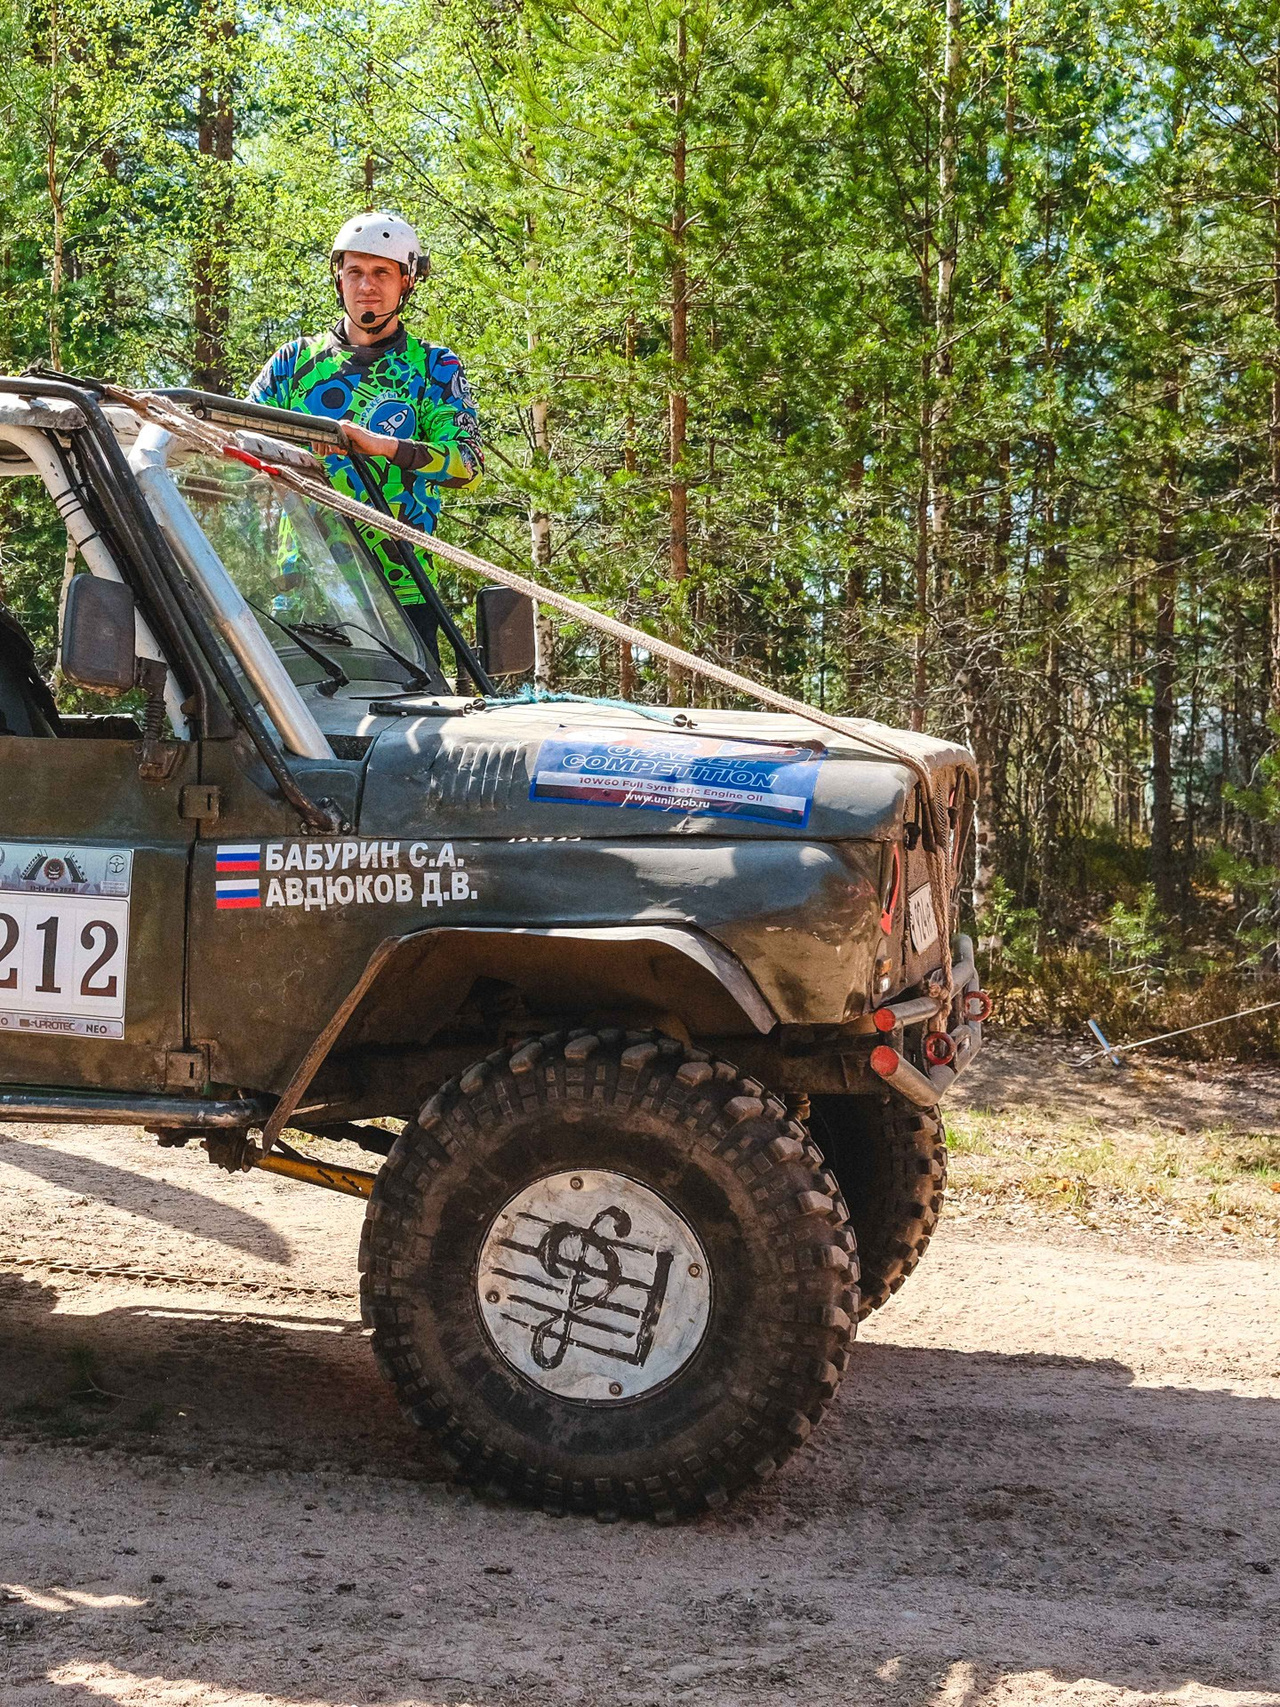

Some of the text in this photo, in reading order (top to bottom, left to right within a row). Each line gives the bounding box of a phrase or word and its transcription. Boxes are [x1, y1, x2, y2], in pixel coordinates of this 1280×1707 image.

[562, 753, 779, 789] COMPETITION
[579, 777, 763, 802] 10W60 Full Synthetic Engine Oil
[266, 841, 465, 871] БАБУРИН С.А.
[265, 871, 478, 911] АВДЮКОВ Д.В.
[86, 1024, 108, 1034] NEO
